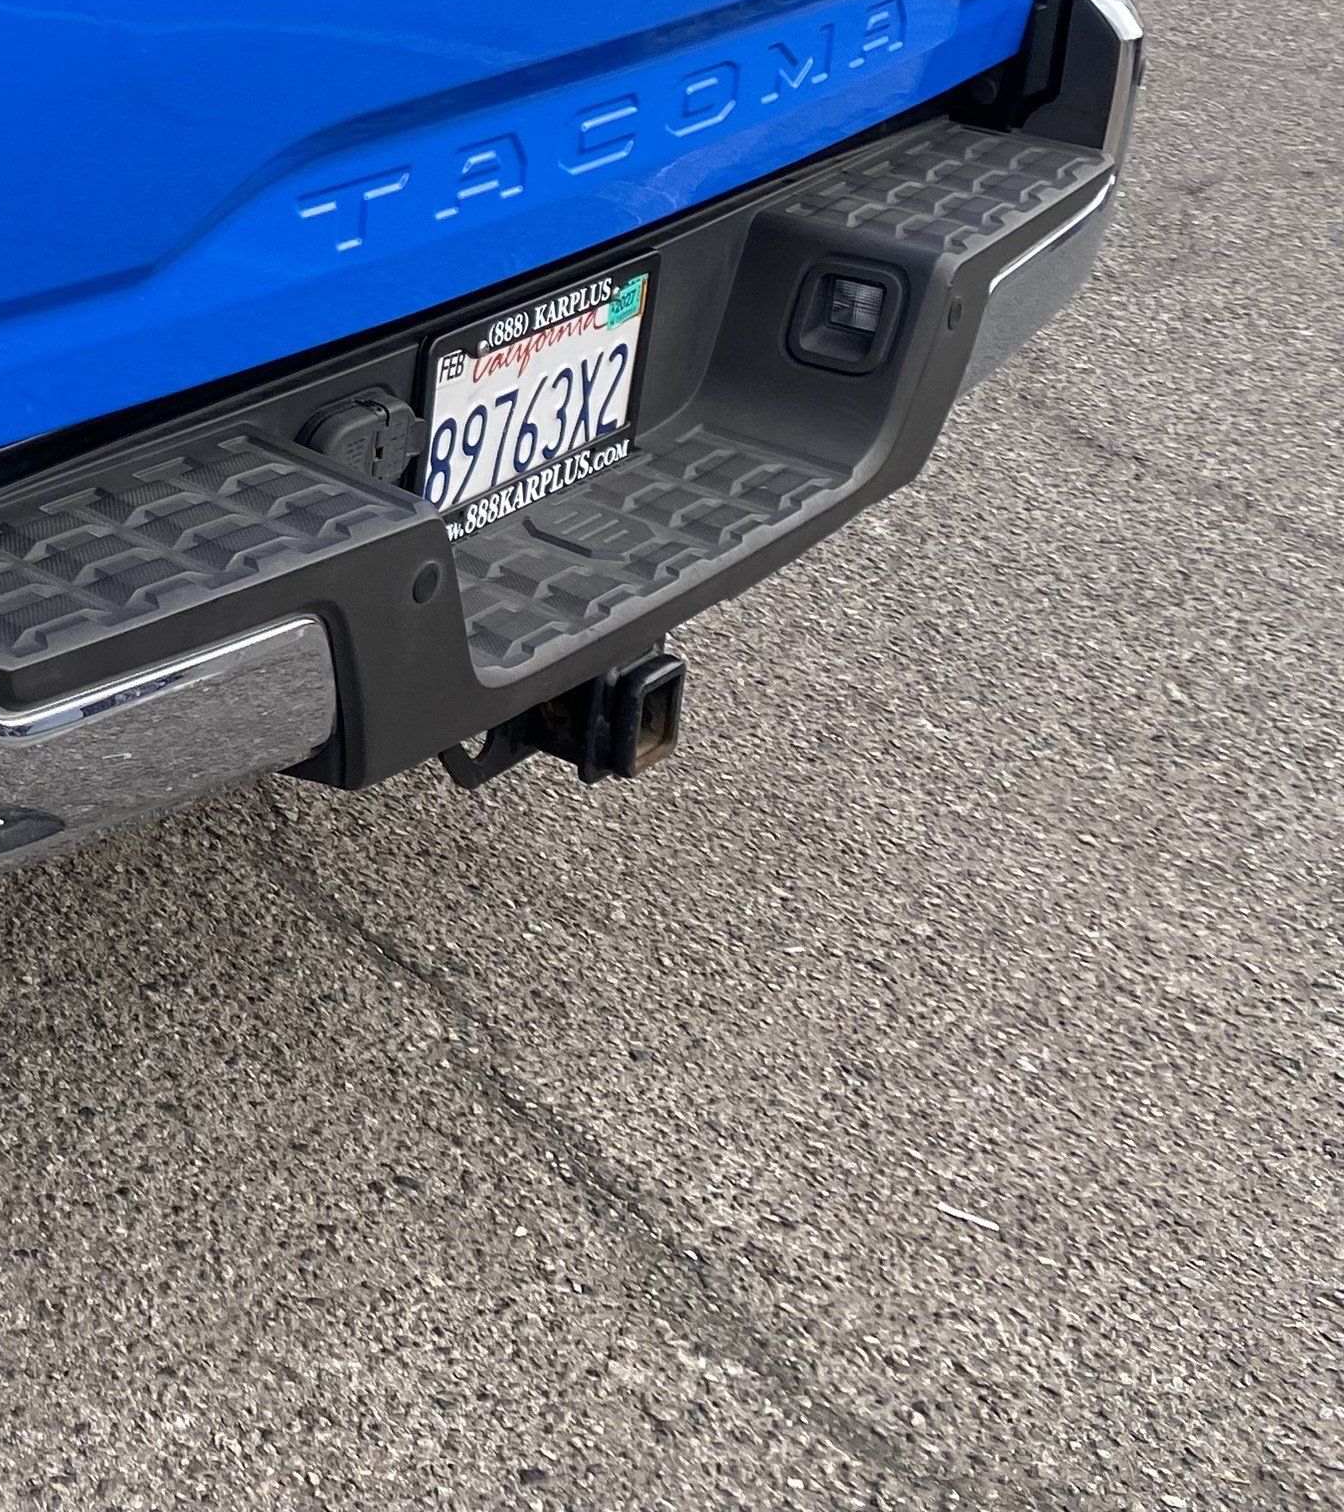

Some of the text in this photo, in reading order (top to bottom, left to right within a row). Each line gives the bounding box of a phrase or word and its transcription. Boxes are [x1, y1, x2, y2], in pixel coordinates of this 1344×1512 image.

[487, 277, 613, 348] (888) KARPLUS
[439, 352, 466, 384] FEB
[423, 342, 629, 511] 89763X2
